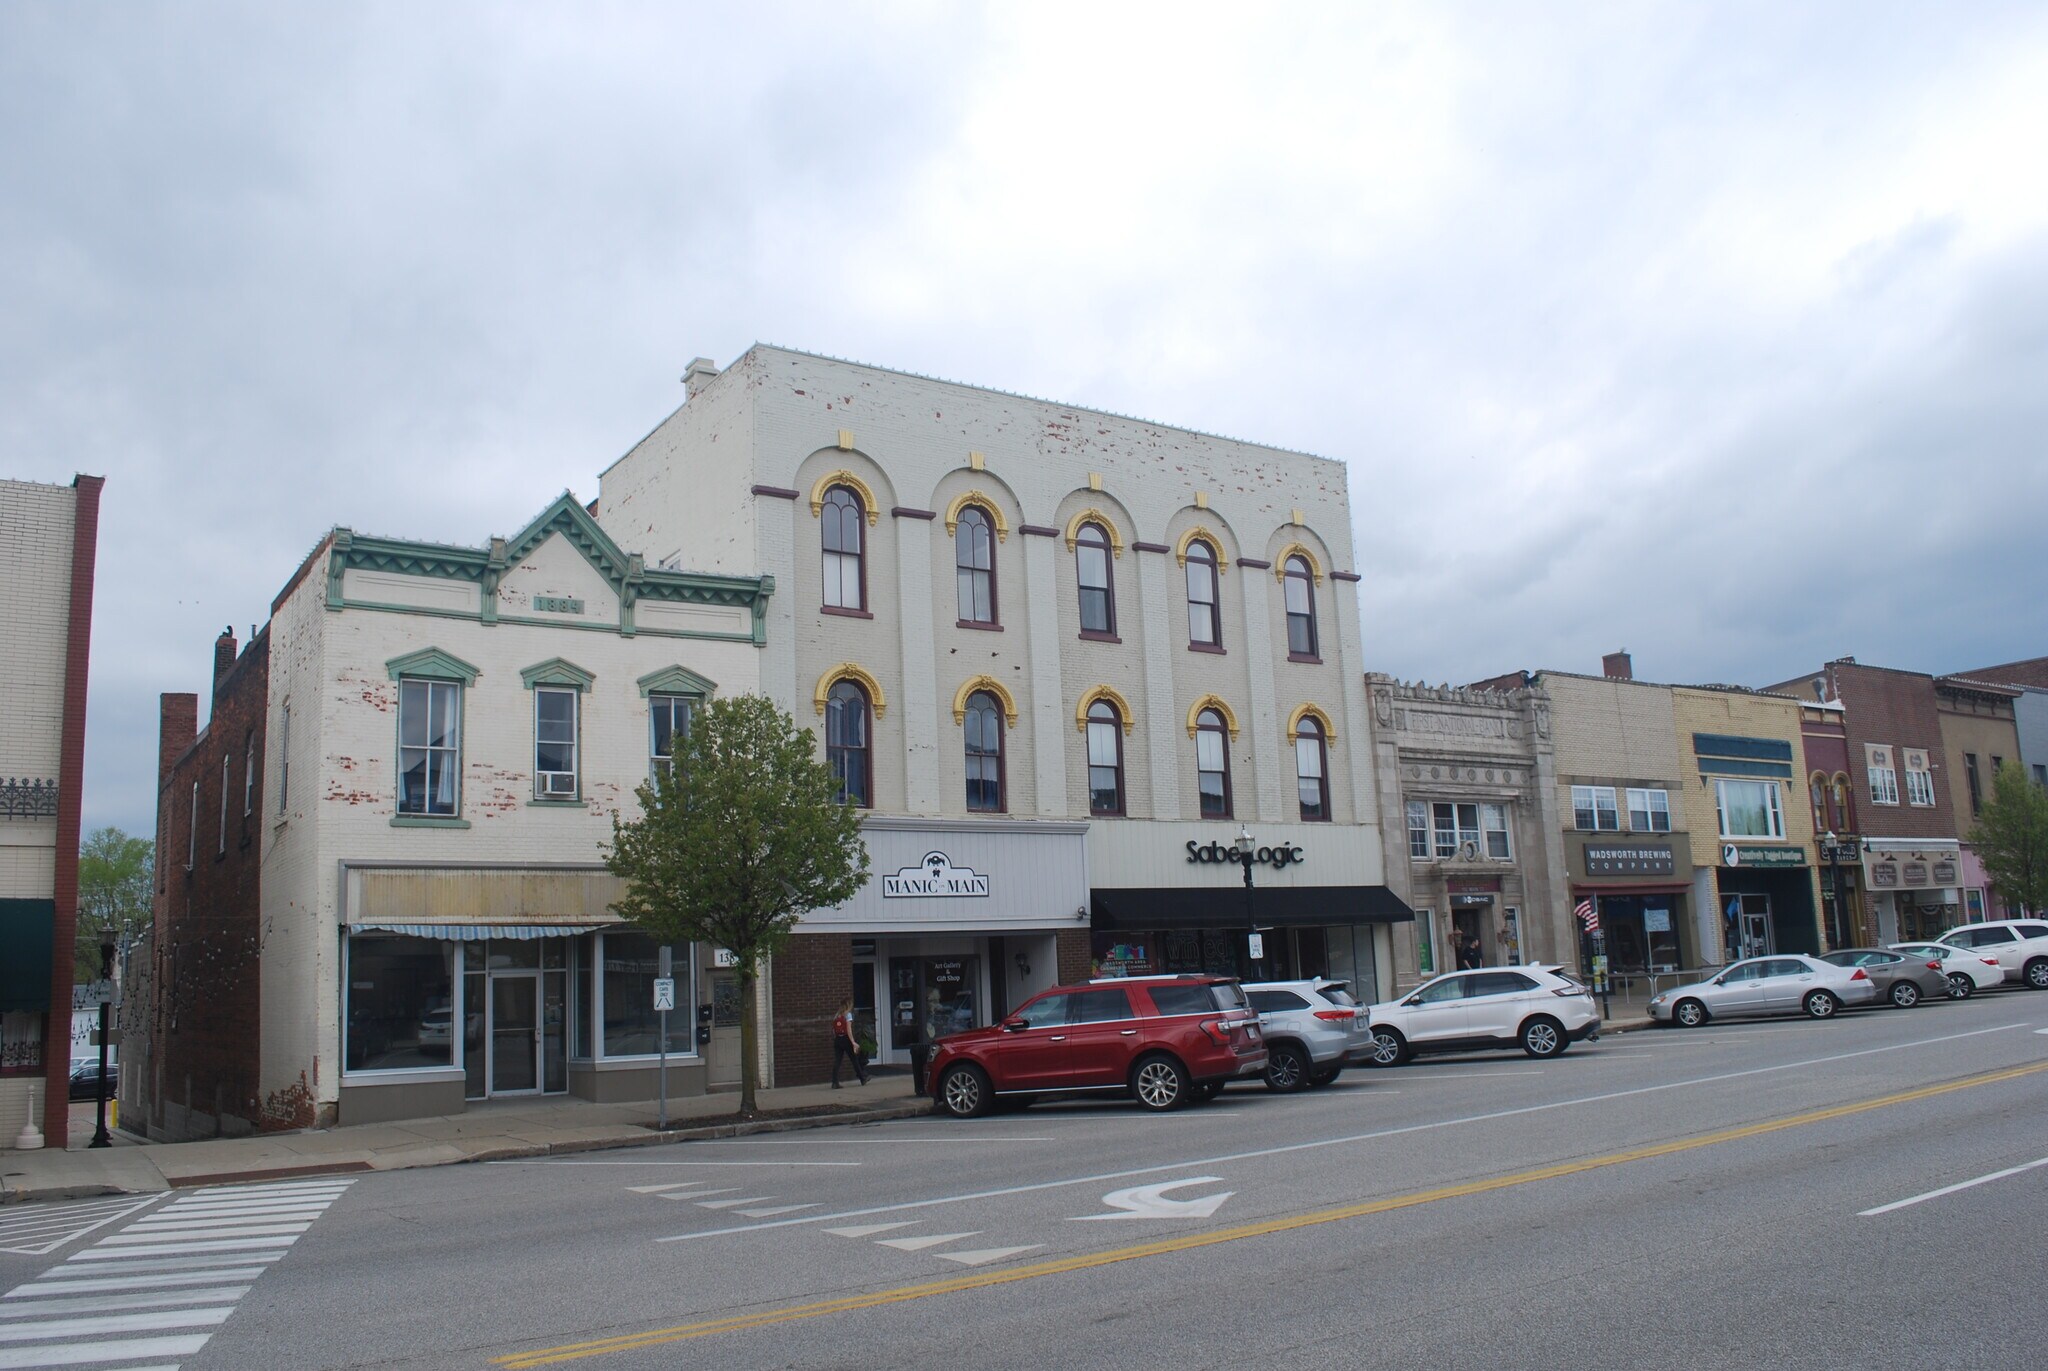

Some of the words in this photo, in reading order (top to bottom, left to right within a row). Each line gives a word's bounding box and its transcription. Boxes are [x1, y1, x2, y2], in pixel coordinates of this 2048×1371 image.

[538, 598, 580, 614] 1884
[1411, 713, 1434, 730] FIRST
[1438, 715, 1475, 733] NATIONAL
[1479, 718, 1502, 736] BANK
[1185, 840, 1304, 869] SabeLogic
[1589, 850, 1637, 859] WADSWORTH
[1638, 850, 1672, 859] BREWING
[1590, 861, 1673, 870] COMPANY
[886, 879, 938, 894] MANIC
[947, 879, 987, 894] MAIN
[943, 962, 962, 970] Gallery
